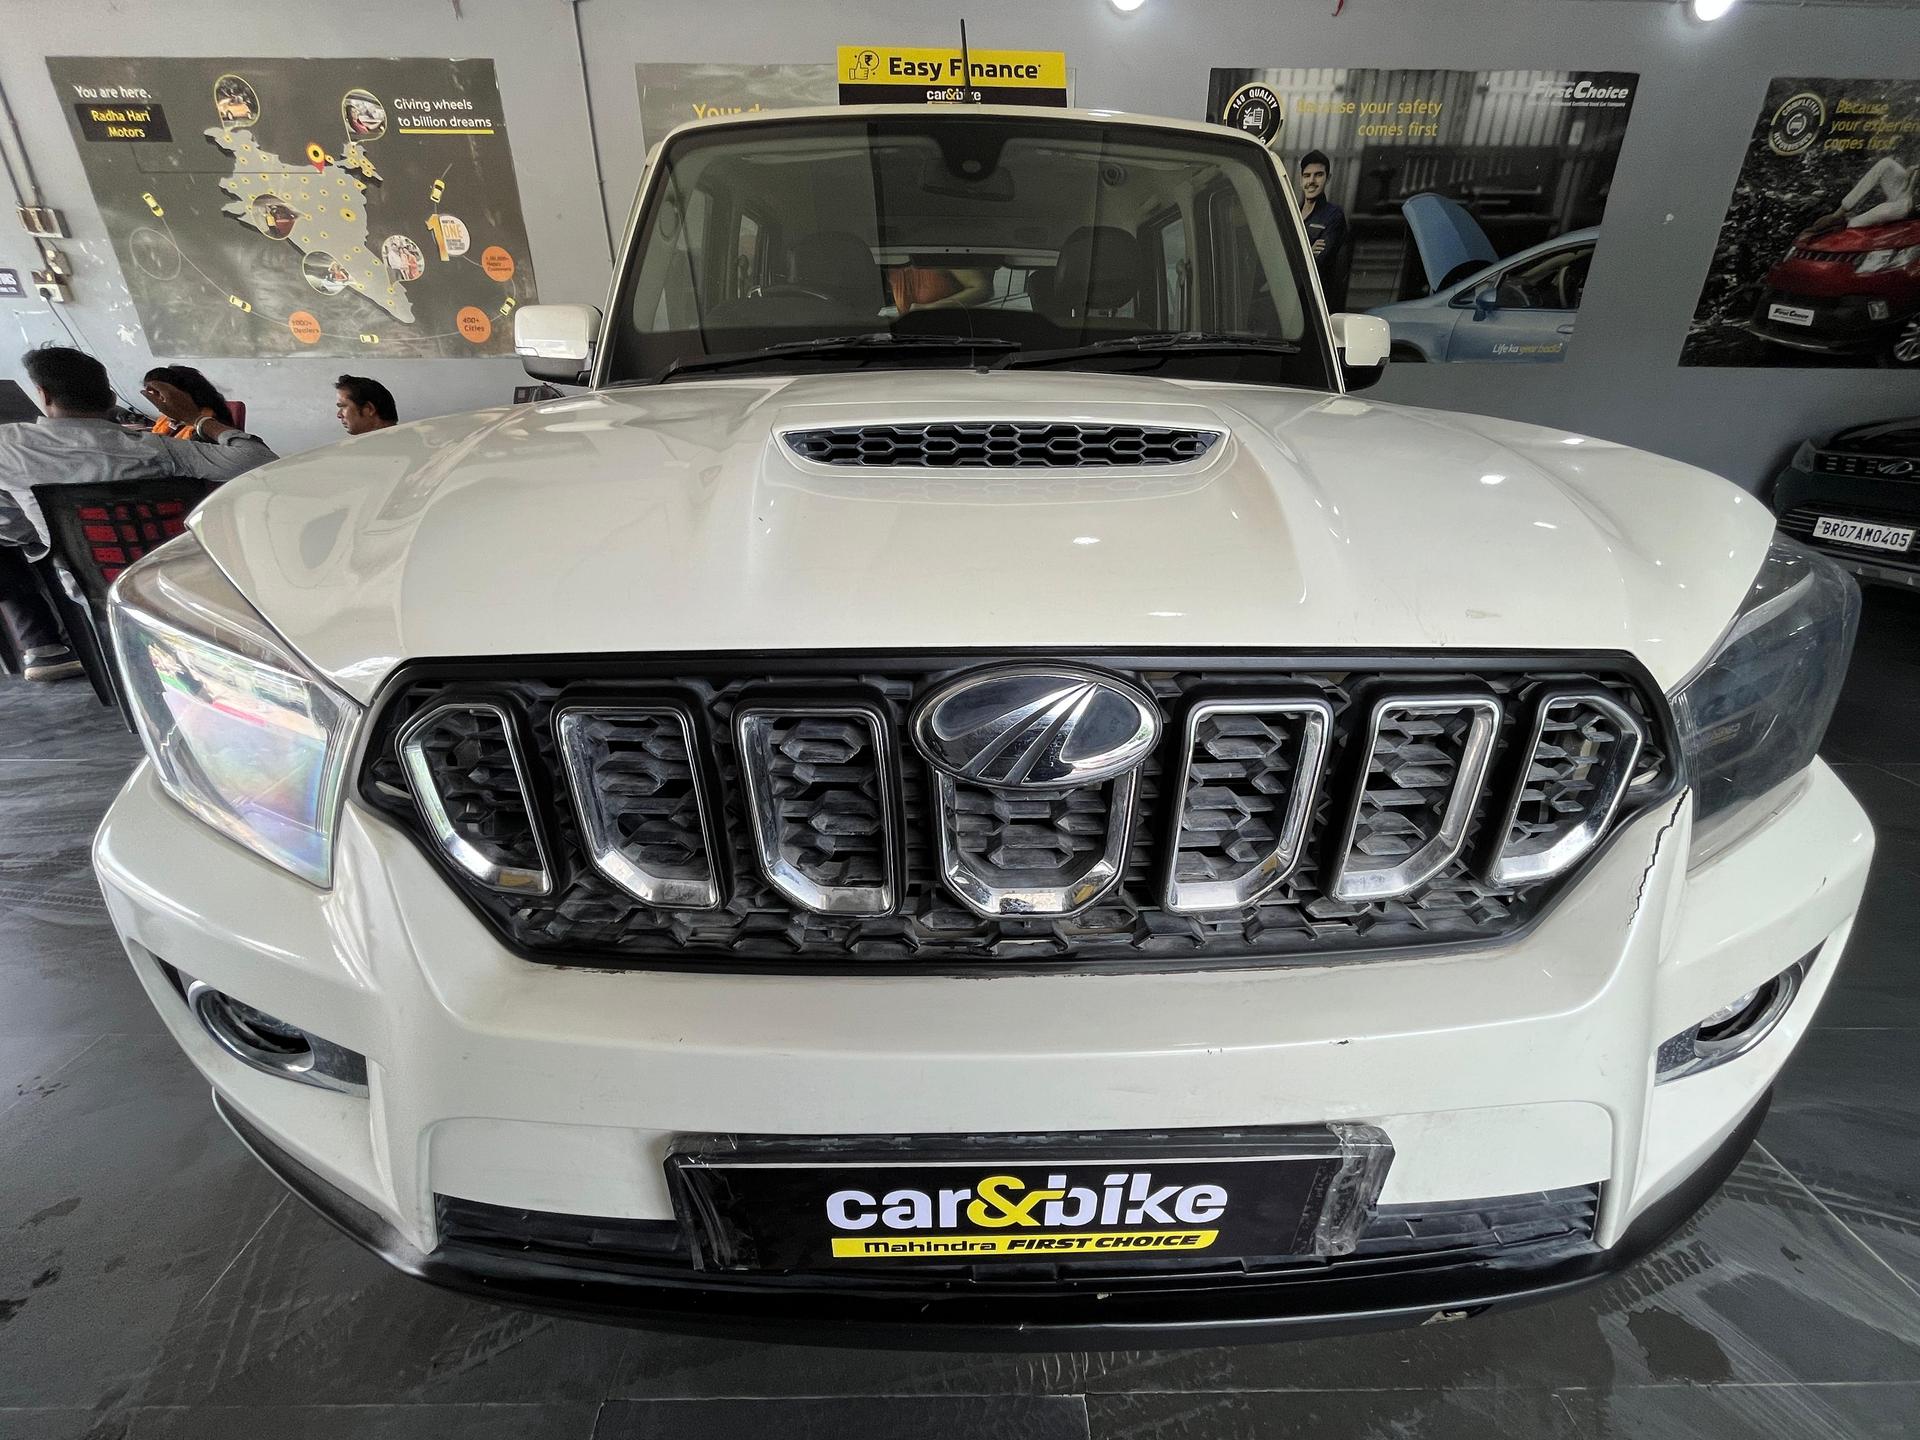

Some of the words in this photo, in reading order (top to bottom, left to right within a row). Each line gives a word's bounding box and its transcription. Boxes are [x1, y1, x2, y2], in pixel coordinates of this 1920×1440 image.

[889, 57, 943, 81] Easy
[950, 58, 1038, 80] Fnance
[73, 85, 98, 98] You
[99, 88, 118, 98] are
[1233, 94, 1246, 109] 140
[1249, 88, 1278, 109] QUALITY
[394, 98, 431, 112] Giving
[432, 99, 473, 110] wheels
[1359, 101, 1393, 117] your
[1397, 98, 1443, 118] safety
[1835, 98, 1889, 114] Because
[91, 109, 126, 121] Radha
[397, 117, 410, 127] to
[412, 116, 447, 127] billion
[449, 116, 492, 127] dreams
[108, 127, 146, 137] Motors
[1358, 123, 1403, 136] comes
[1408, 121, 1438, 136] first
[1828, 120, 1861, 135] your
[1824, 137, 1865, 151] comes
[464, 324, 485, 332] Cities
[1822, 520, 1910, 547] BR07AM0405
[826, 1173, 1228, 1229] car&bike
[865, 1241, 997, 1253] Mahindra
[1007, 1238, 1095, 1250] FIRST
[1095, 1235, 1201, 1249] CHOICE
